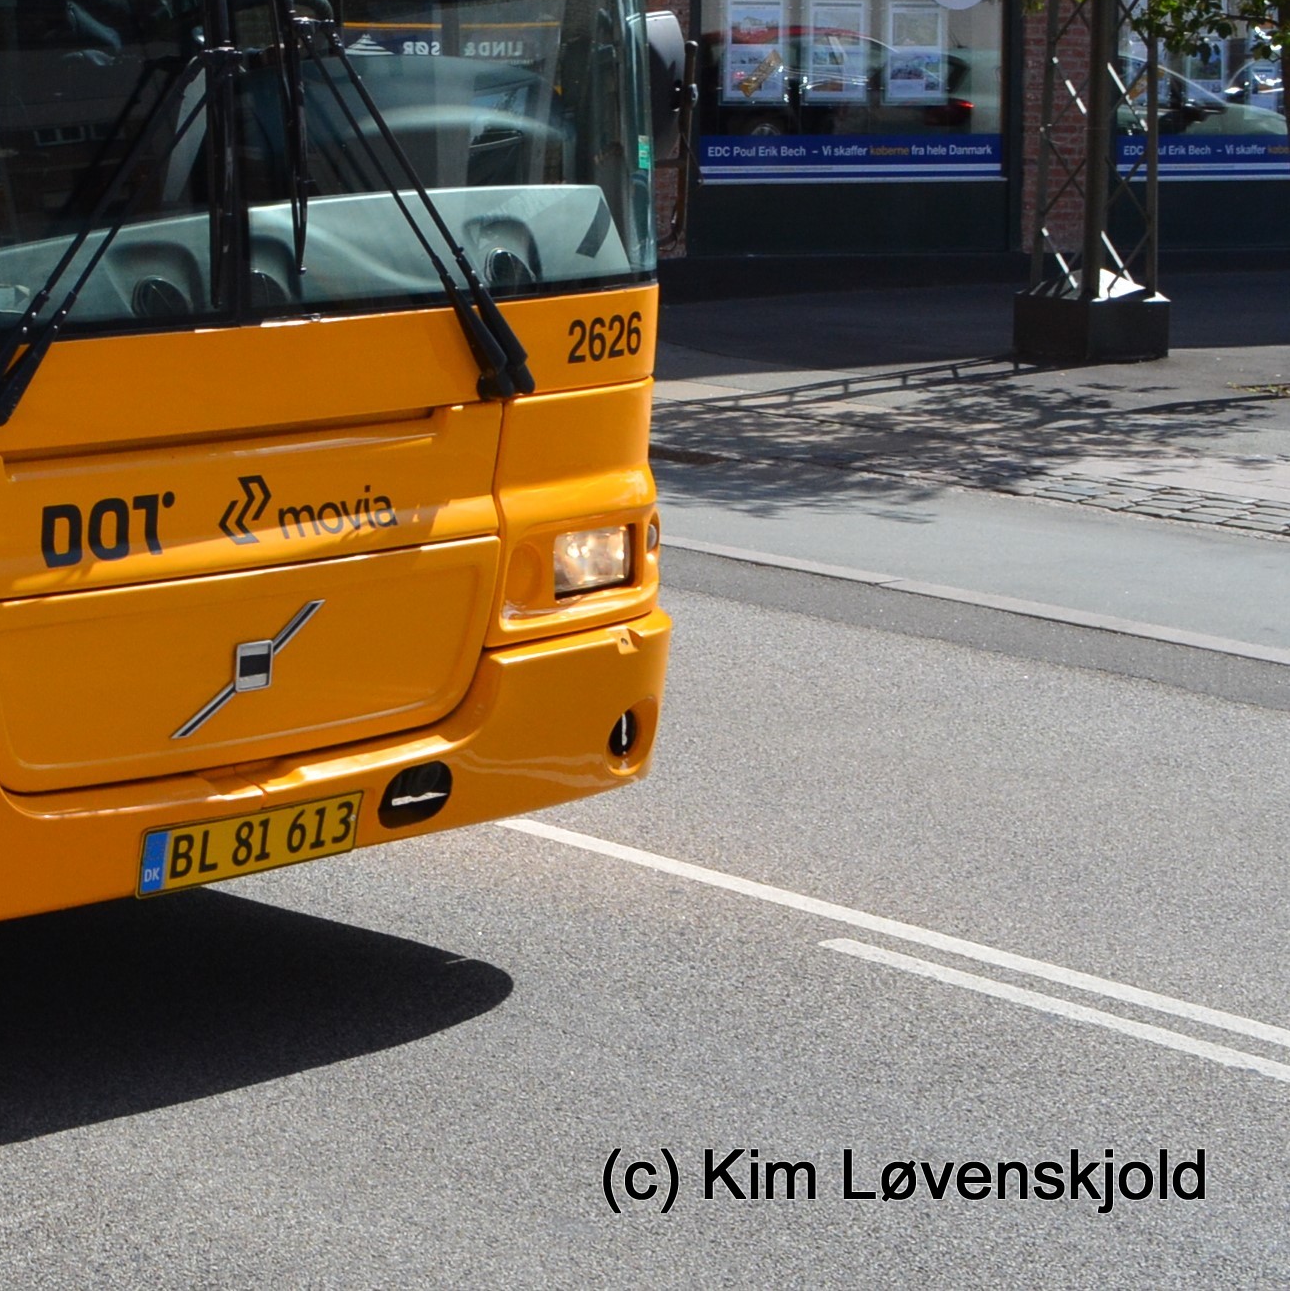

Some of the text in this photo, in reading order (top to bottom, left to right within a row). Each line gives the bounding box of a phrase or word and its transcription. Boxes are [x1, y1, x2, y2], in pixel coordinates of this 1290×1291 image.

[708, 146, 730, 158] EDC
[733, 146, 756, 158] Poul
[758, 145, 778, 158] Erik
[780, 145, 806, 157] Bech
[822, 145, 832, 157] Vi
[833, 145, 868, 157] skaffer
[870, 145, 910, 156] køberne
[911, 144, 925, 156] fra
[926, 144, 947, 156] hele
[949, 144, 992, 156] Danmark
[1124, 145, 1144, 156] EDC
[1168, 145, 1186, 156] Erik
[1188, 145, 1211, 156] Bech
[1225, 144, 1234, 155] Vi
[1236, 144, 1266, 155] skaffer
[567, 311, 642, 365] 2626
[277, 483, 399, 540] movia
[169, 800, 354, 880] BL 81 613
[144, 867, 160, 883] DK
